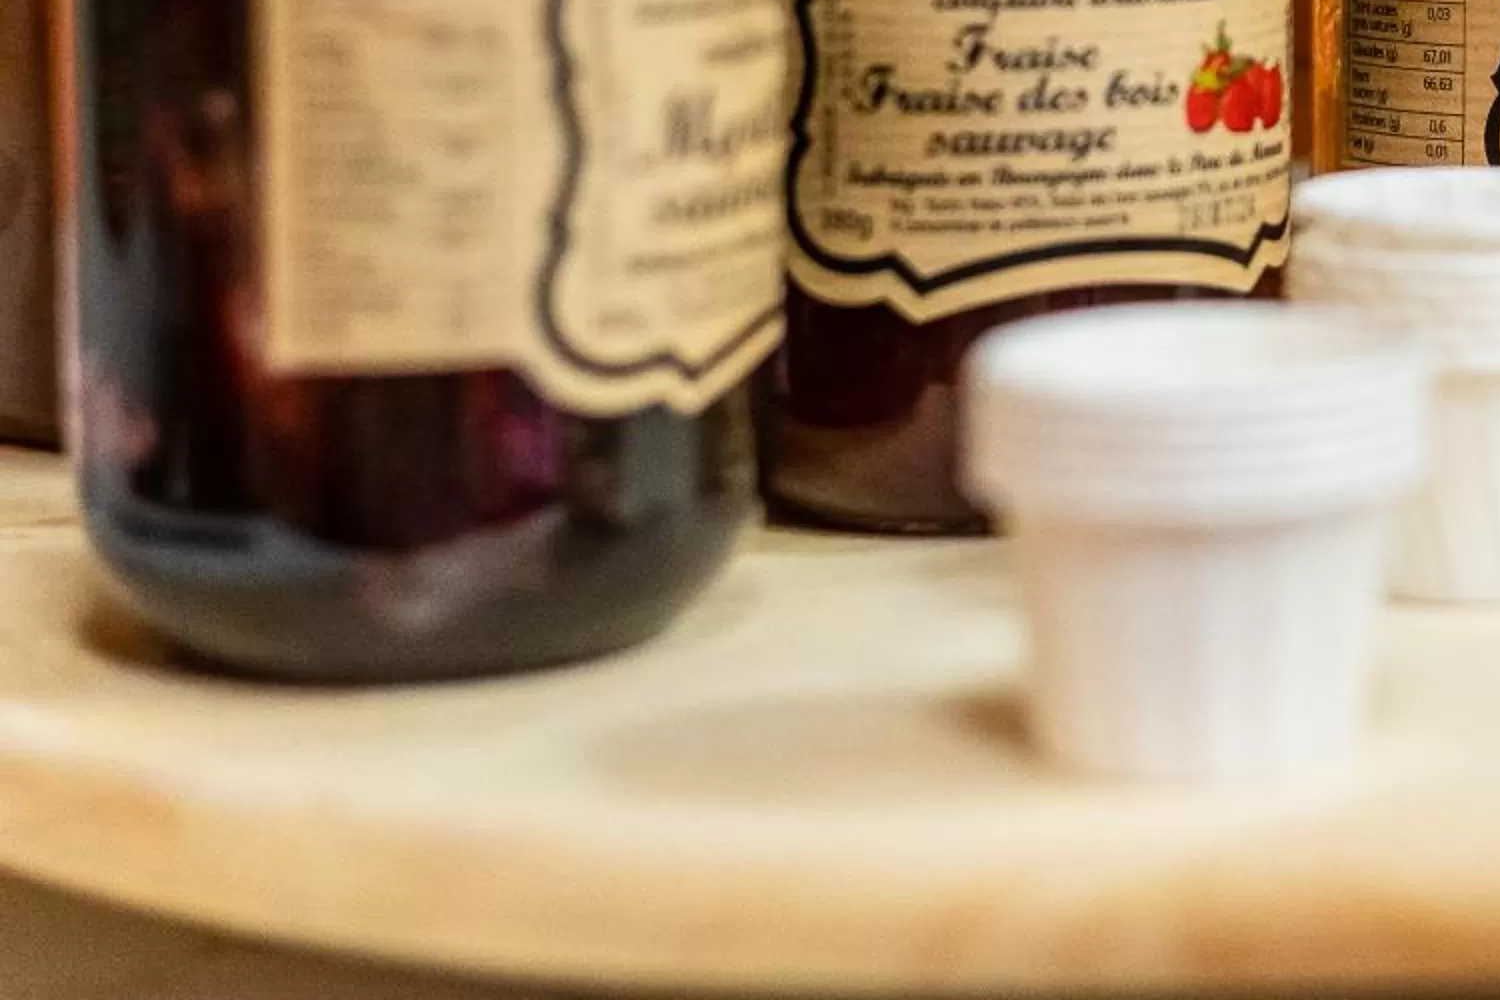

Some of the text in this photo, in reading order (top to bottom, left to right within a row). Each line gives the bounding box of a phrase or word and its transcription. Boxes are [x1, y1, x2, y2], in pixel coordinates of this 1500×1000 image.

[1427, 7, 1451, 21] 0,03
[944, 22, 1099, 73] Fraise
[850, 63, 1179, 117] Fraise des bois
[924, 125, 1117, 161] sauvage
